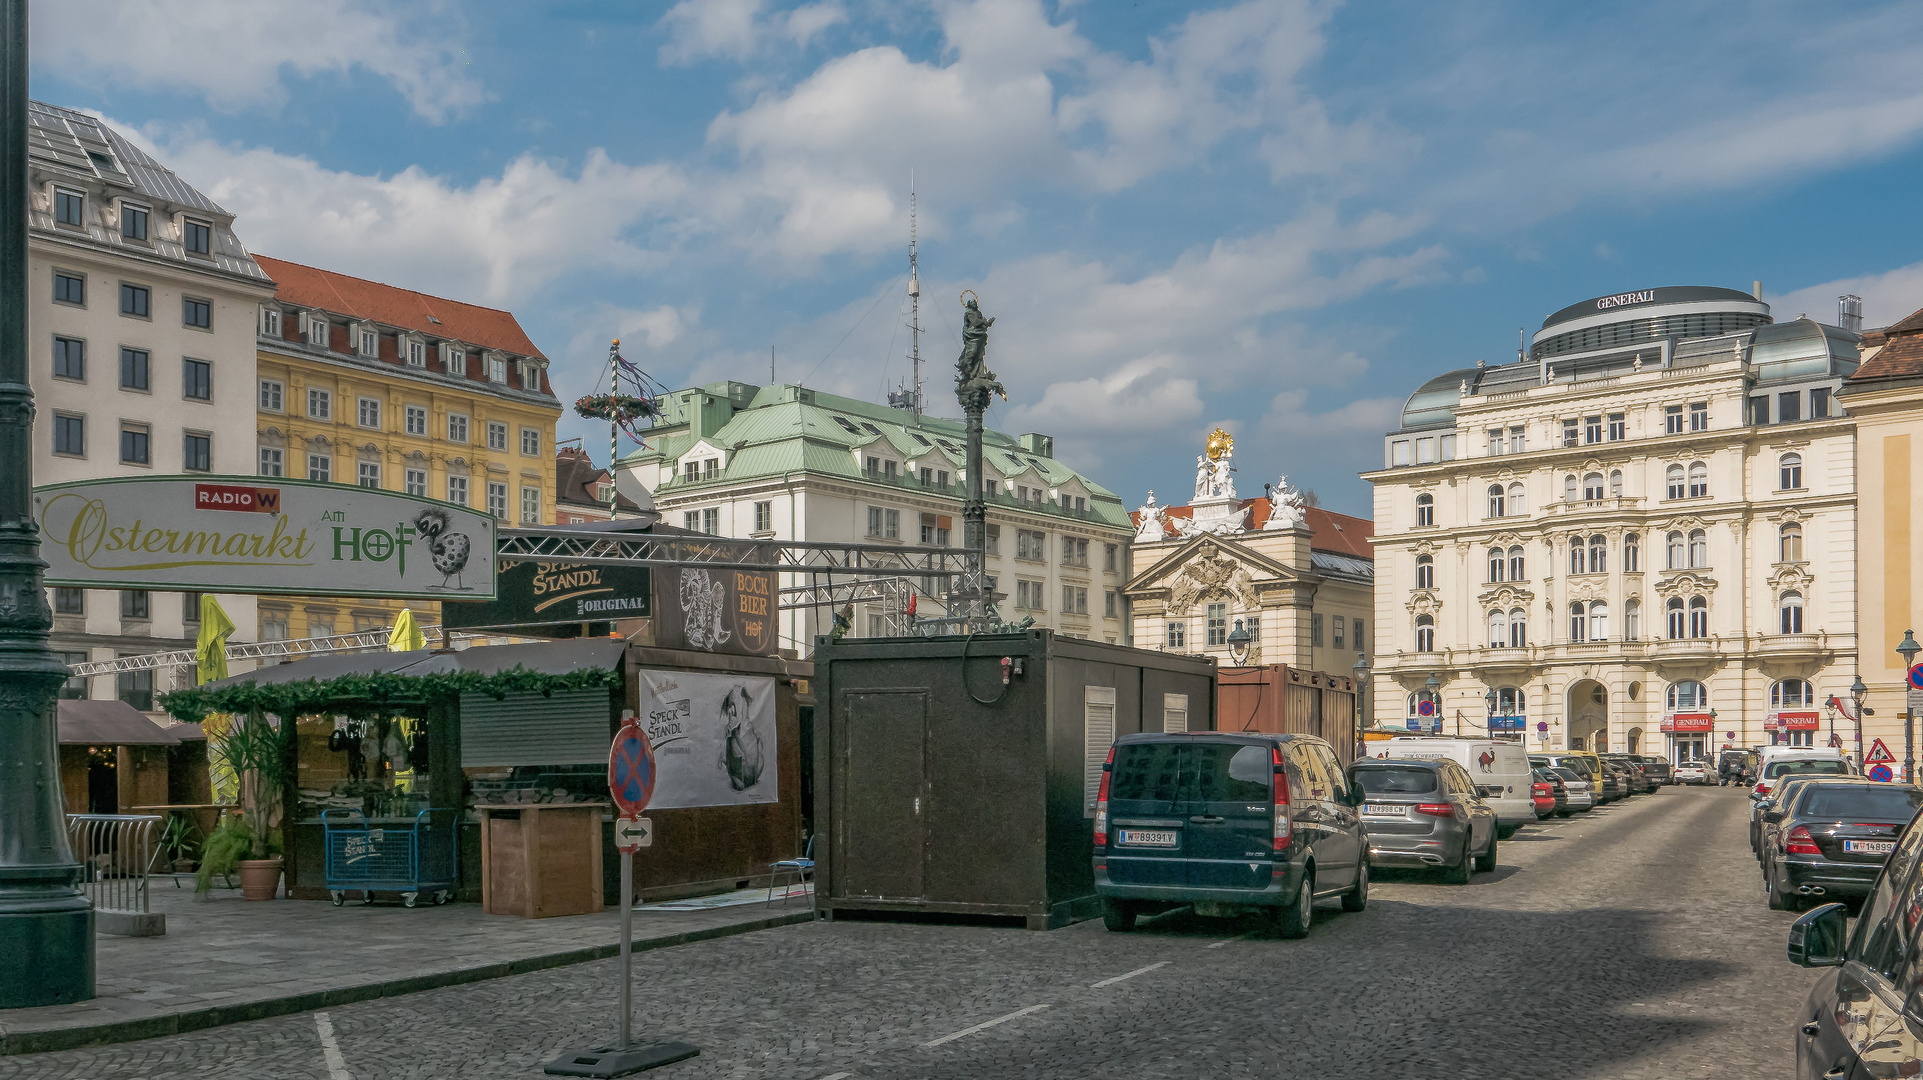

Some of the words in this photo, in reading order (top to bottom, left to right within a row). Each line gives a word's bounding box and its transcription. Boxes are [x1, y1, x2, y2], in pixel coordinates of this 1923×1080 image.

[1597, 290, 1655, 310] GENERALI
[199, 491, 252, 505] RADIO
[257, 493, 277, 508] W
[41, 493, 316, 570] Ostermarkt
[532, 569, 601, 595] STANDL
[736, 573, 769, 596] BOCK
[584, 597, 645, 613] ORIGINAL
[740, 594, 768, 616] BIER
[649, 709, 679, 726] SPECK
[1785, 717, 1816, 725] ENERALI
[648, 723, 682, 741] STANDL
